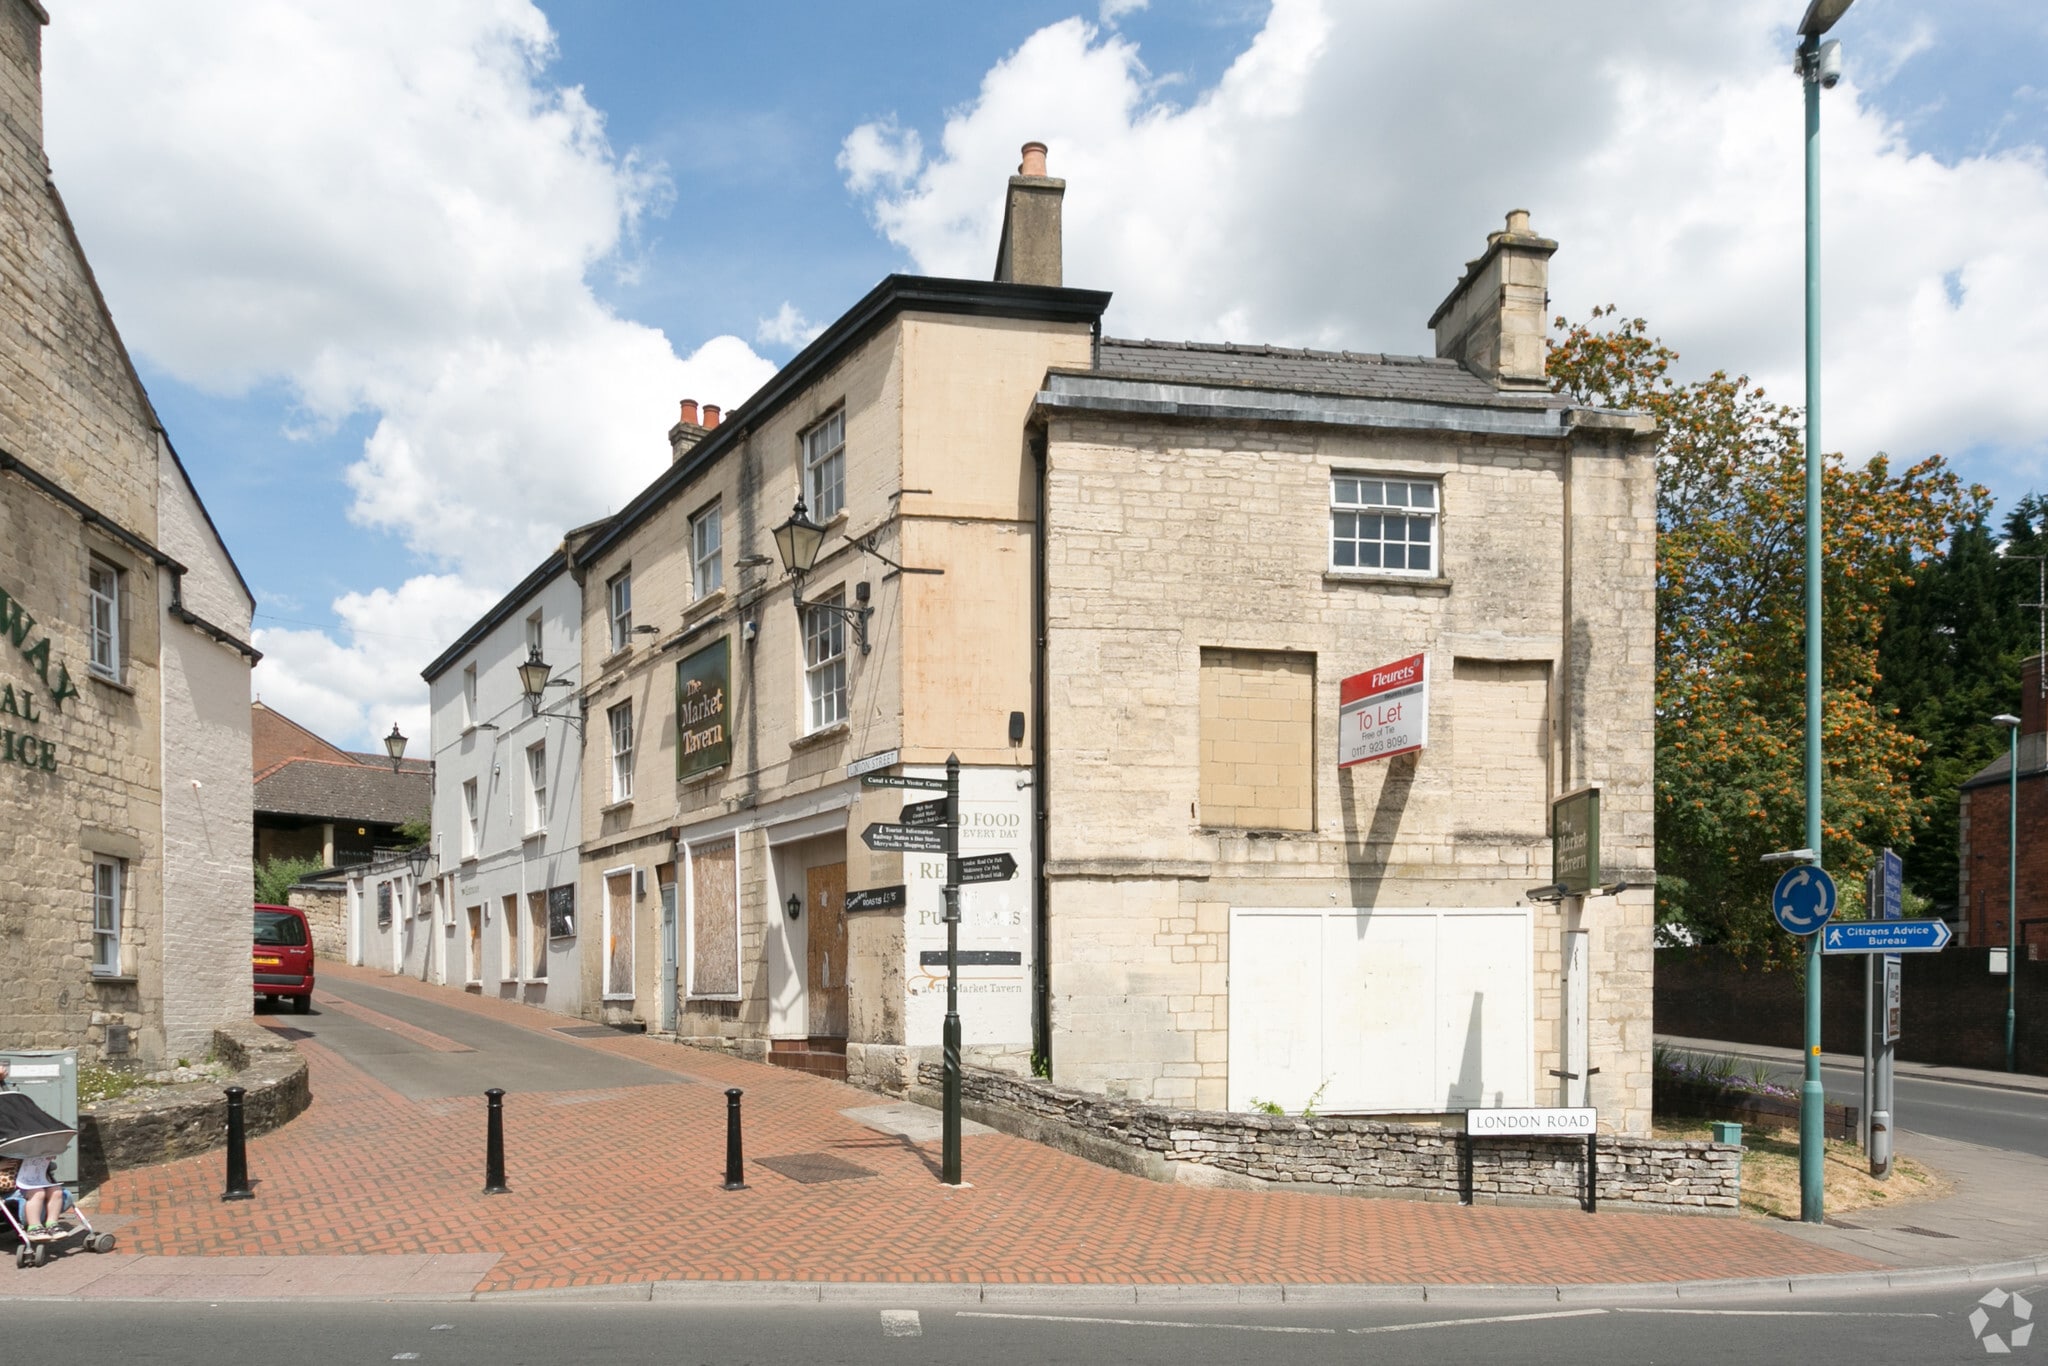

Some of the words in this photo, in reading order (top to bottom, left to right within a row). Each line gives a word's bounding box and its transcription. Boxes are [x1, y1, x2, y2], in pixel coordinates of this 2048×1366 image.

[1371, 665, 1415, 688] Fleurets
[686, 679, 702, 697] The
[682, 687, 723, 727] Market
[1356, 711, 1373, 731] To
[1378, 702, 1402, 726] Let
[683, 724, 723, 756] Tavern
[1361, 731, 1375, 740] Free
[1376, 728, 1384, 737] of
[1385, 726, 1395, 735] Tie
[0, 727, 57, 772] ICE
[1351, 745, 1366, 758] 0117
[1369, 741, 1384, 753] 923
[1386, 734, 1408, 748] 8090
[871, 752, 895, 769] STREET
[974, 813, 1020, 827] FOOD
[872, 833, 892, 841] Railway
[963, 829, 997, 839] EVERY
[1000, 829, 1019, 838] DAY
[1558, 831, 1587, 852] Market
[1559, 854, 1587, 873] Tavern
[1846, 927, 1890, 936] Citizens
[1893, 926, 1929, 935] Advice
[1868, 936, 1907, 945] Bureau
[935, 983, 949, 993] Th
[989, 984, 1022, 993] Tavern
[1476, 1116, 1541, 1129] LONDON
[1547, 1115, 1590, 1128] ROAD
